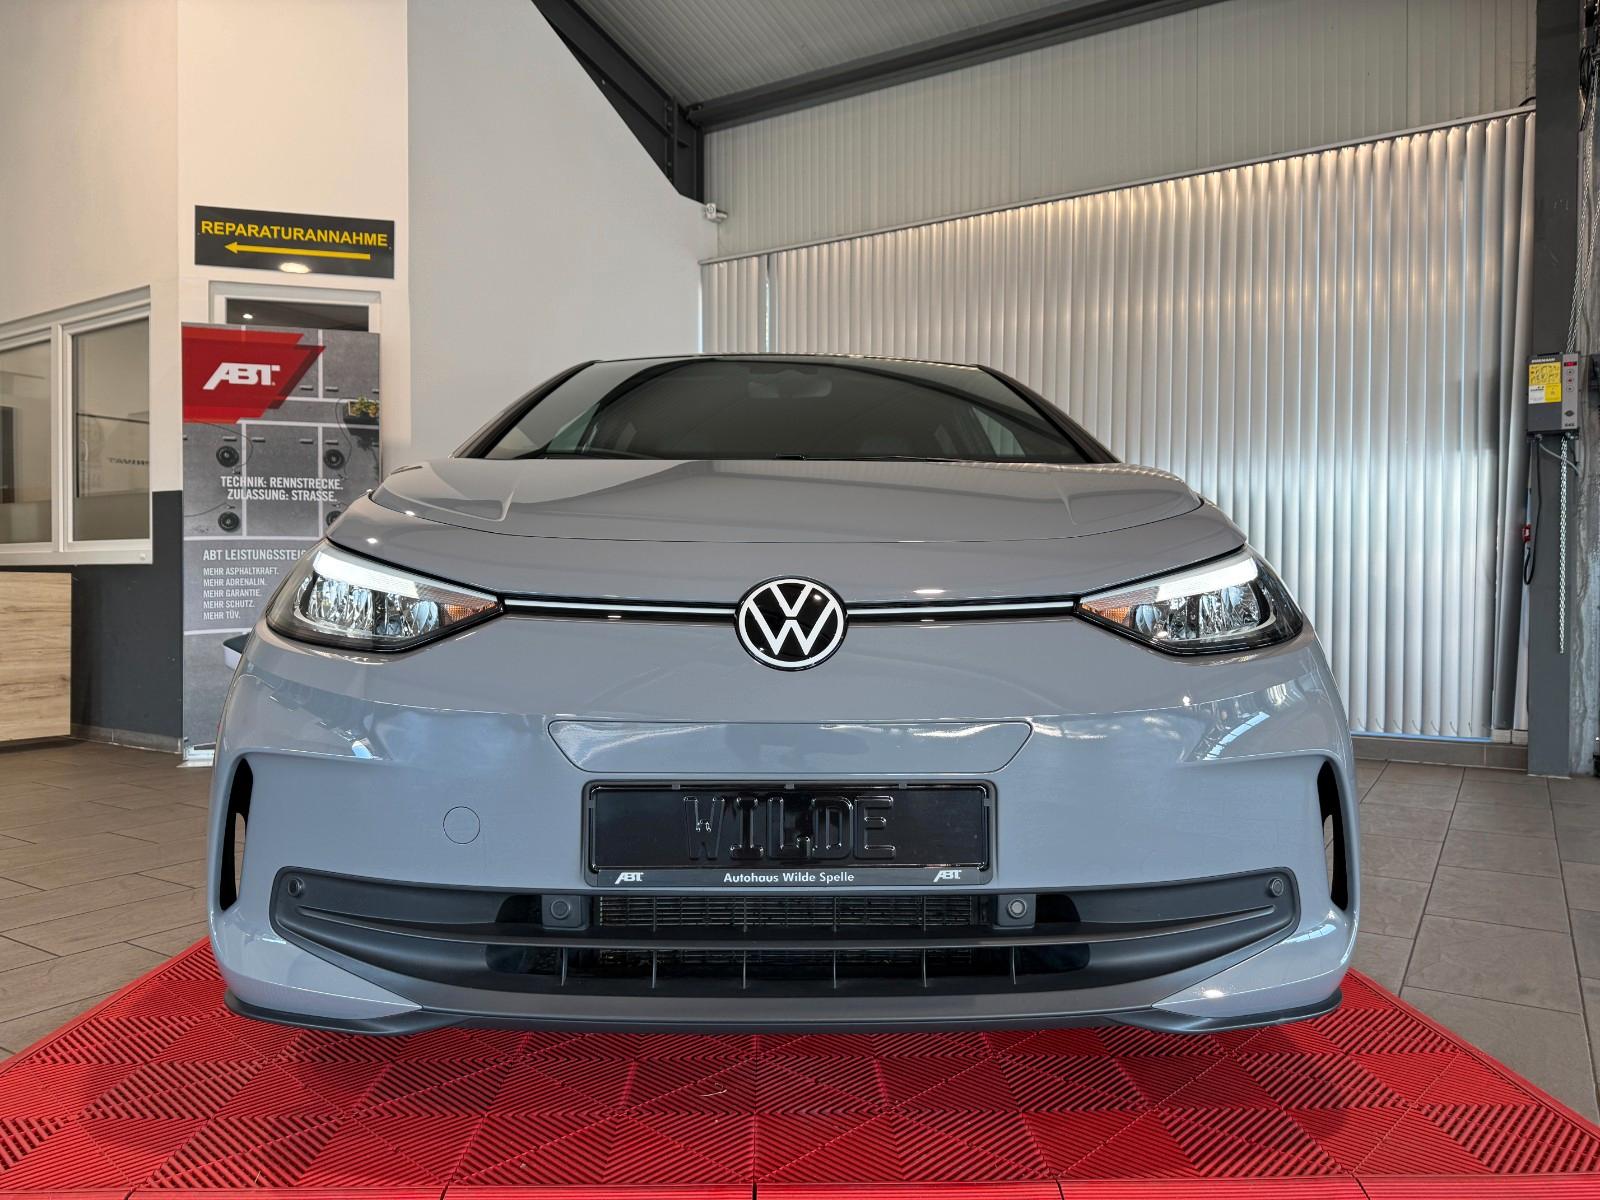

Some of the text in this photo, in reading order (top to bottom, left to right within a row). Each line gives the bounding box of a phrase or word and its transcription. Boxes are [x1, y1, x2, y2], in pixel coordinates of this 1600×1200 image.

[201, 220, 388, 247] REPARATURANNAHME
[202, 362, 281, 390] ABT
[221, 476, 343, 490] TECHNIK: RENNSTRECKE.
[227, 489, 338, 502] ZULASSUNG: STRASSE.
[203, 549, 306, 561] ABT LEISTUNGSSTEI
[203, 567, 280, 576] MEHR ASPHALTKRAFT.
[203, 578, 266, 587] MEHR ADRENALIN.
[203, 589, 223, 598] MEHR
[203, 600, 255, 609] MEHR SCHUTZ.
[203, 610, 241, 620] MEHR TÜV.
[742, 580, 841, 664] VW
[683, 795, 897, 860] WILDE
[615, 872, 643, 885] ABT
[723, 872, 855, 884] Autohaus Wilde Spelle
[933, 870, 962, 883] ABT
